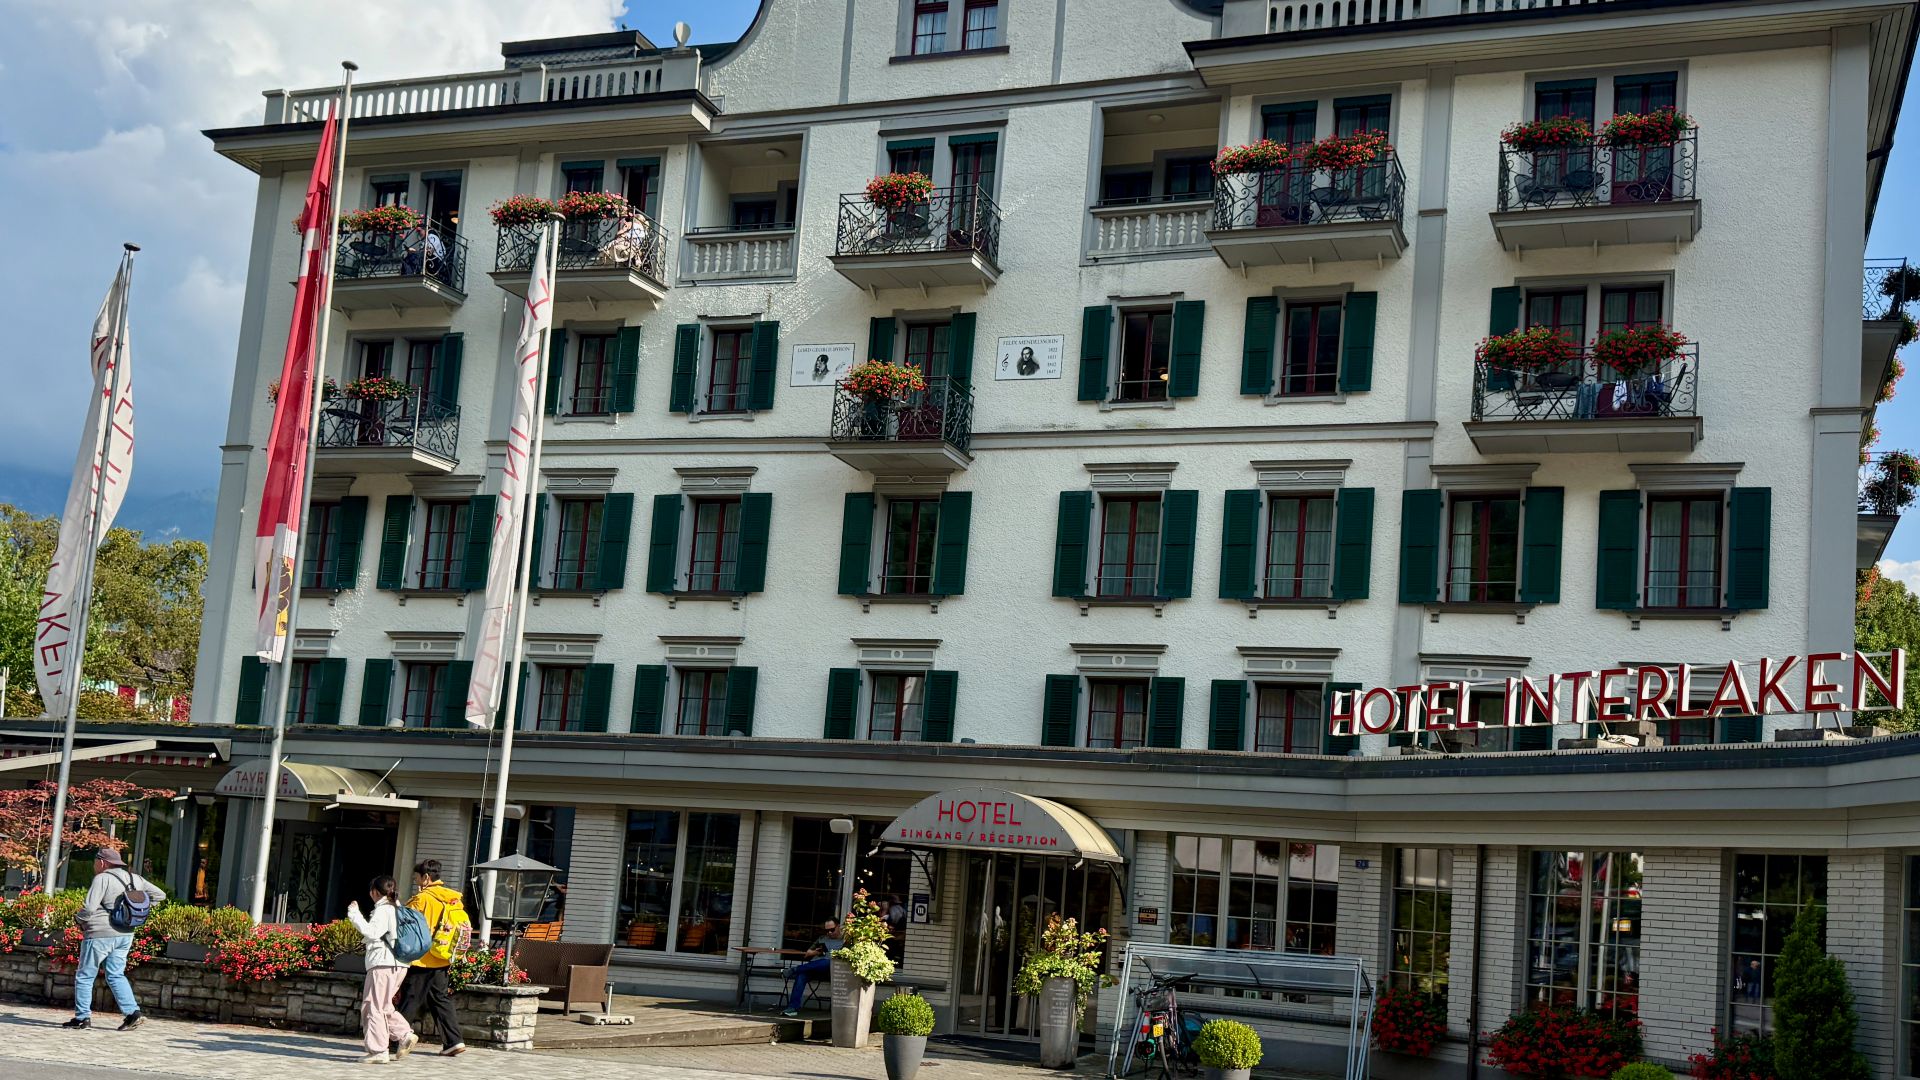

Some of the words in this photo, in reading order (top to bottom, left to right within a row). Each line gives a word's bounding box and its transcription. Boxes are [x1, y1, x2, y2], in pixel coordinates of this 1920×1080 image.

[1329, 681, 1485, 736] HOTEL
[1503, 647, 1905, 727] INTERLAKEN
[938, 799, 1022, 827] HOTEL
[901, 828, 962, 841] EINGANG
[979, 831, 1058, 846] RÉCEPTION
